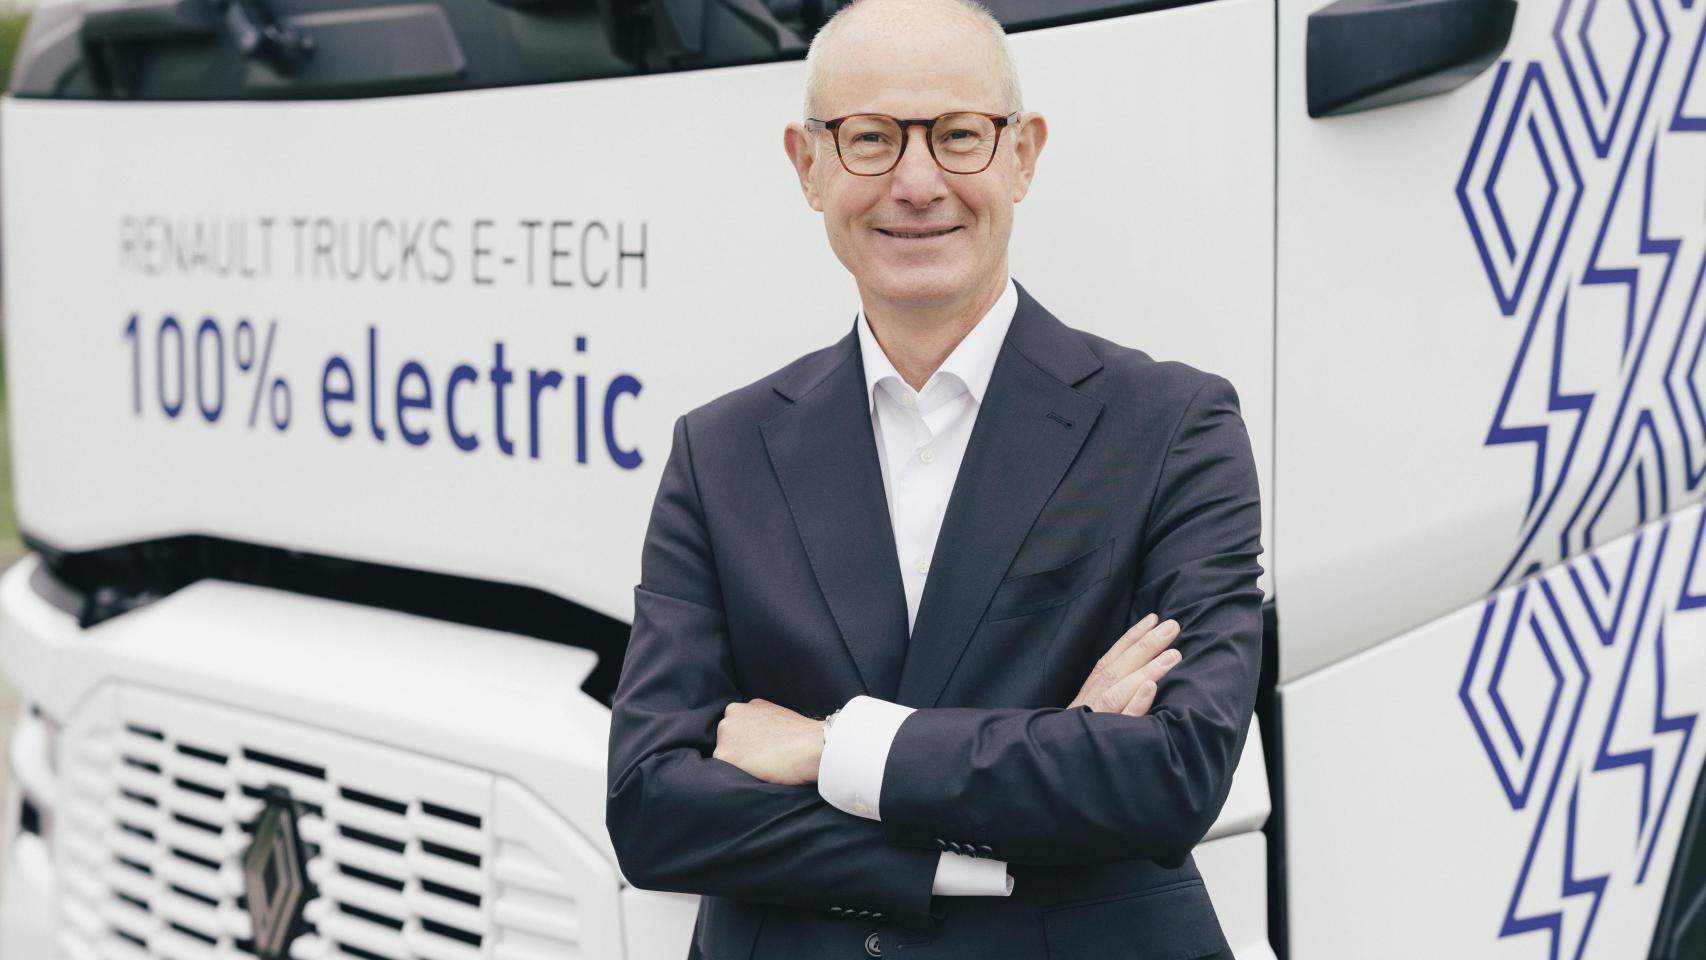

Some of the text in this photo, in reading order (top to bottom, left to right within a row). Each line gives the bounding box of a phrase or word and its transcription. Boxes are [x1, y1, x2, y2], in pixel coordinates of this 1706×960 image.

[118, 215, 648, 289] RENAULT TRUCKS E-TECH
[122, 311, 645, 471] 100% electric
